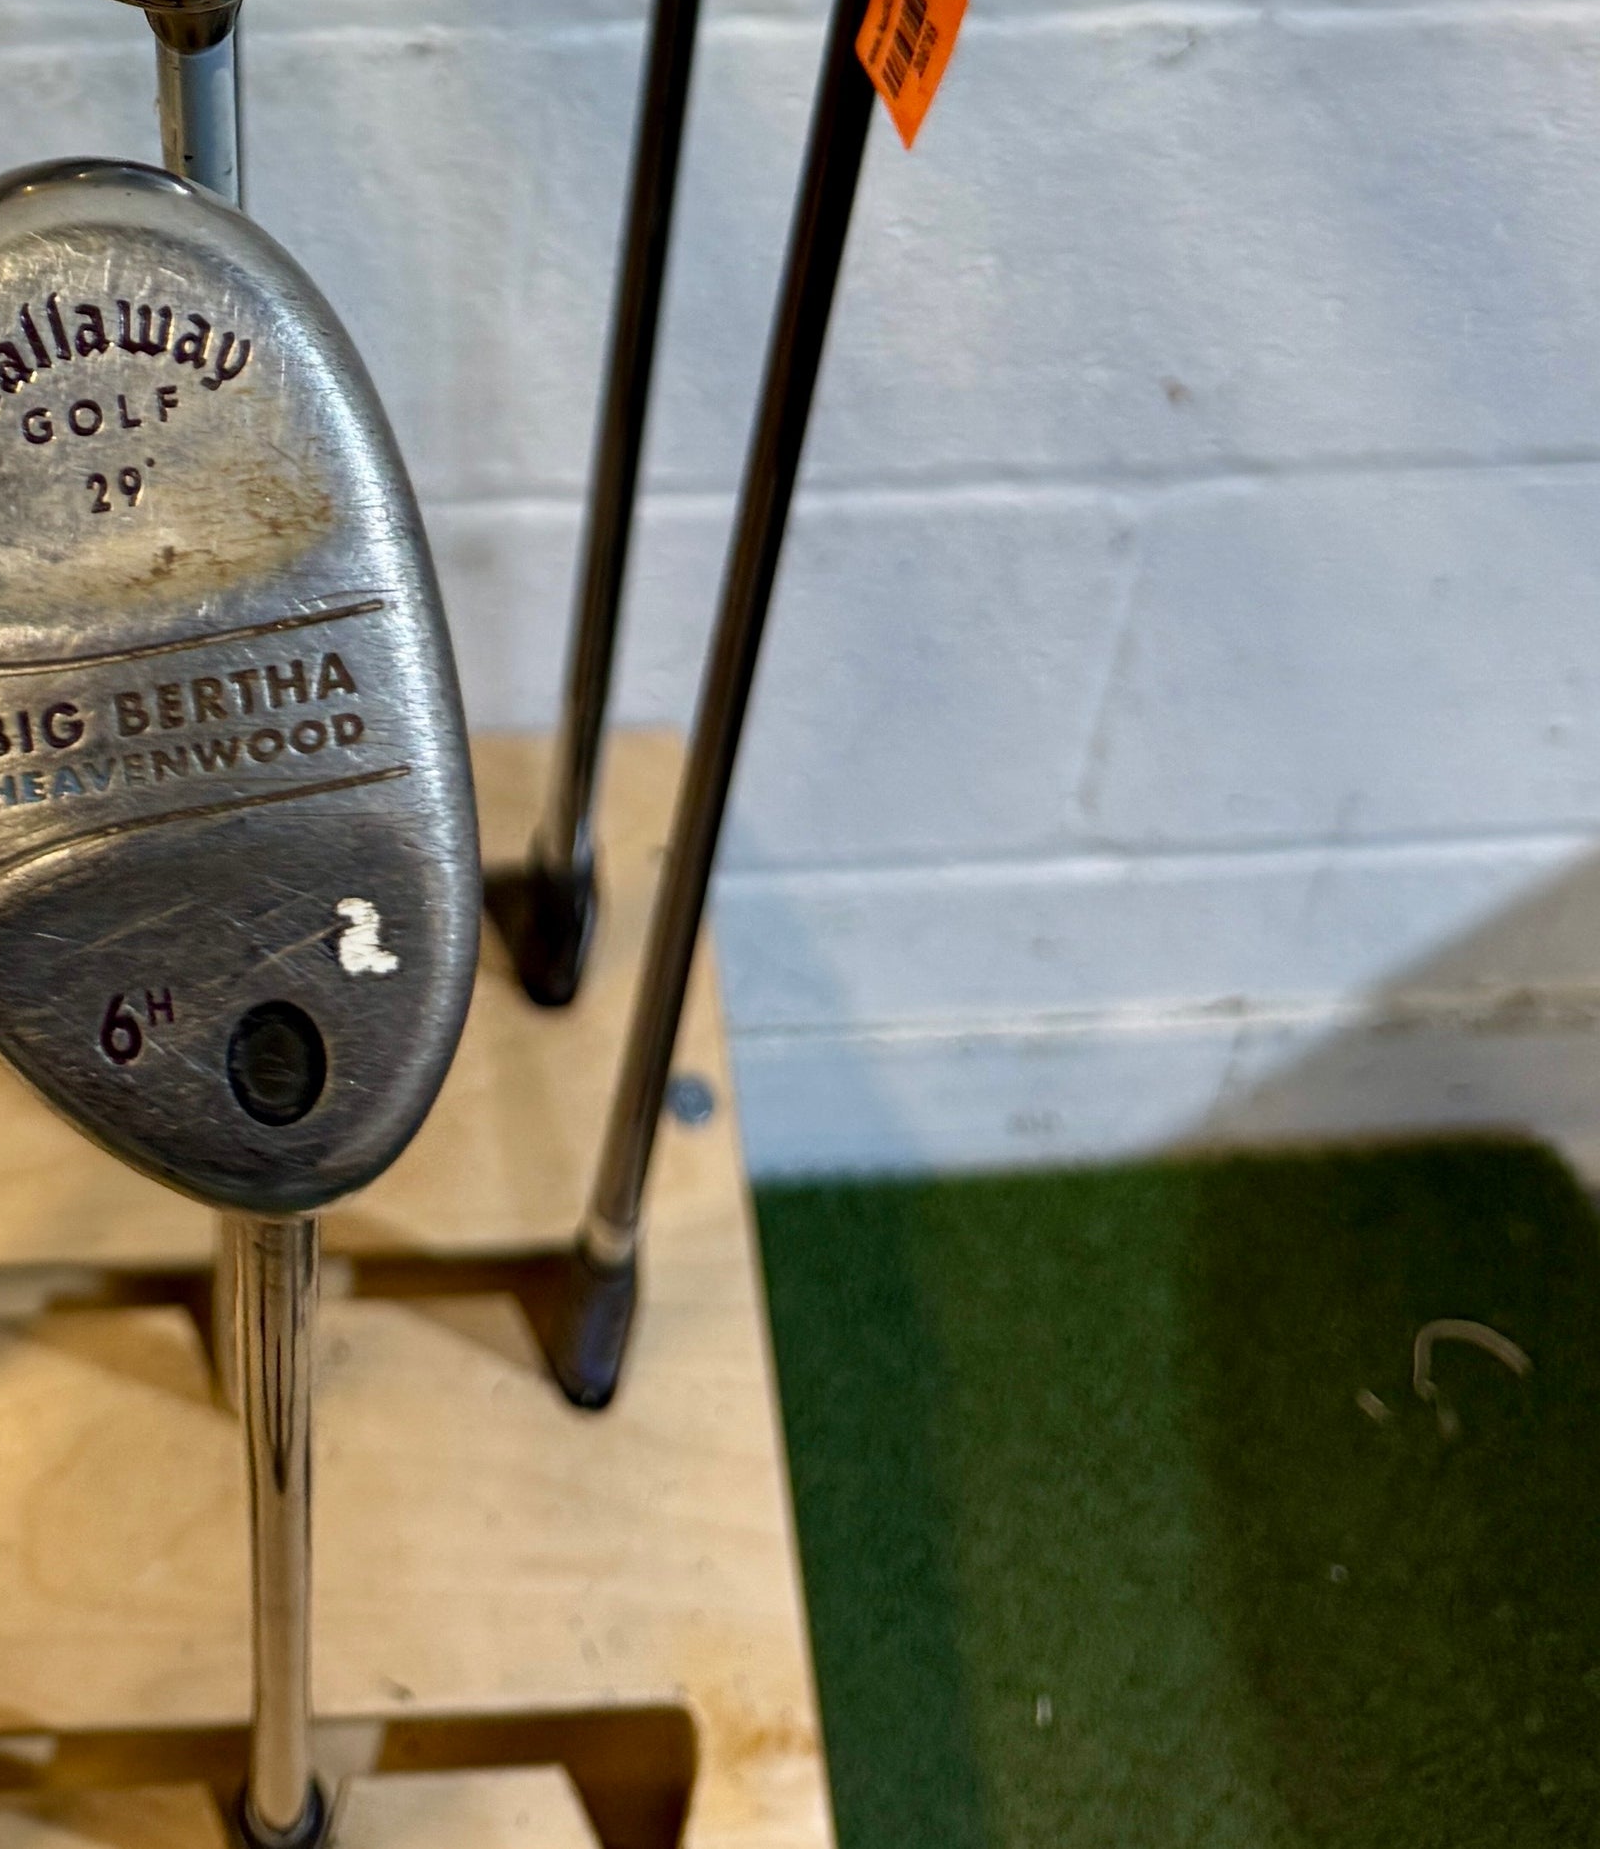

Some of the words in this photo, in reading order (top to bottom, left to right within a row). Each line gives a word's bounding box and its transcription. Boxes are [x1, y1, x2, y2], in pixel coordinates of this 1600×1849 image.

[21, 385, 179, 444] GOLF
[114, 652, 359, 739] BERTHA
[99, 985, 176, 1067] 6H
